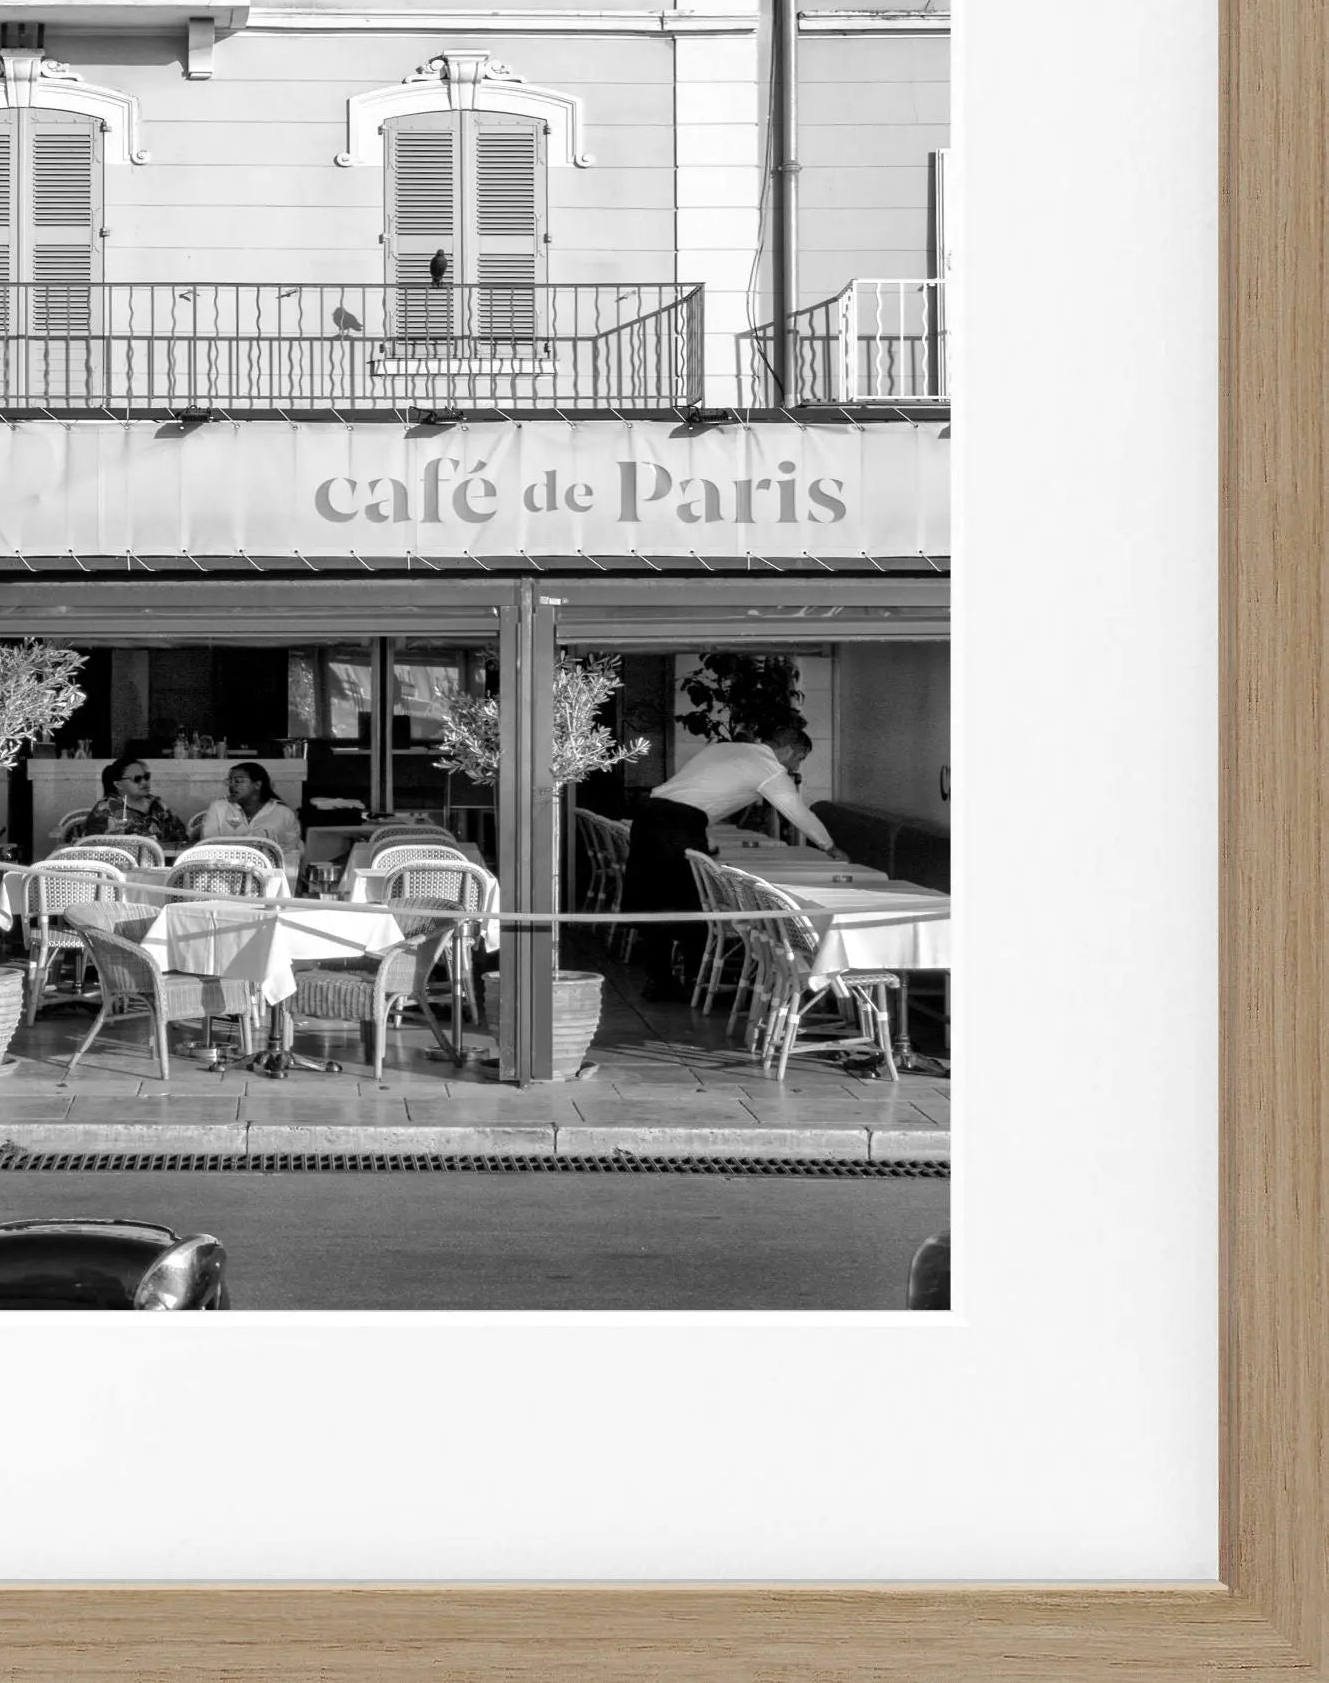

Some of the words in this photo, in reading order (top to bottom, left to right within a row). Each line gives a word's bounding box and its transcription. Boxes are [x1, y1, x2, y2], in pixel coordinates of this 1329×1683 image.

[314, 457, 498, 524] café
[522, 469, 594, 513] de
[615, 460, 847, 524] Paris
